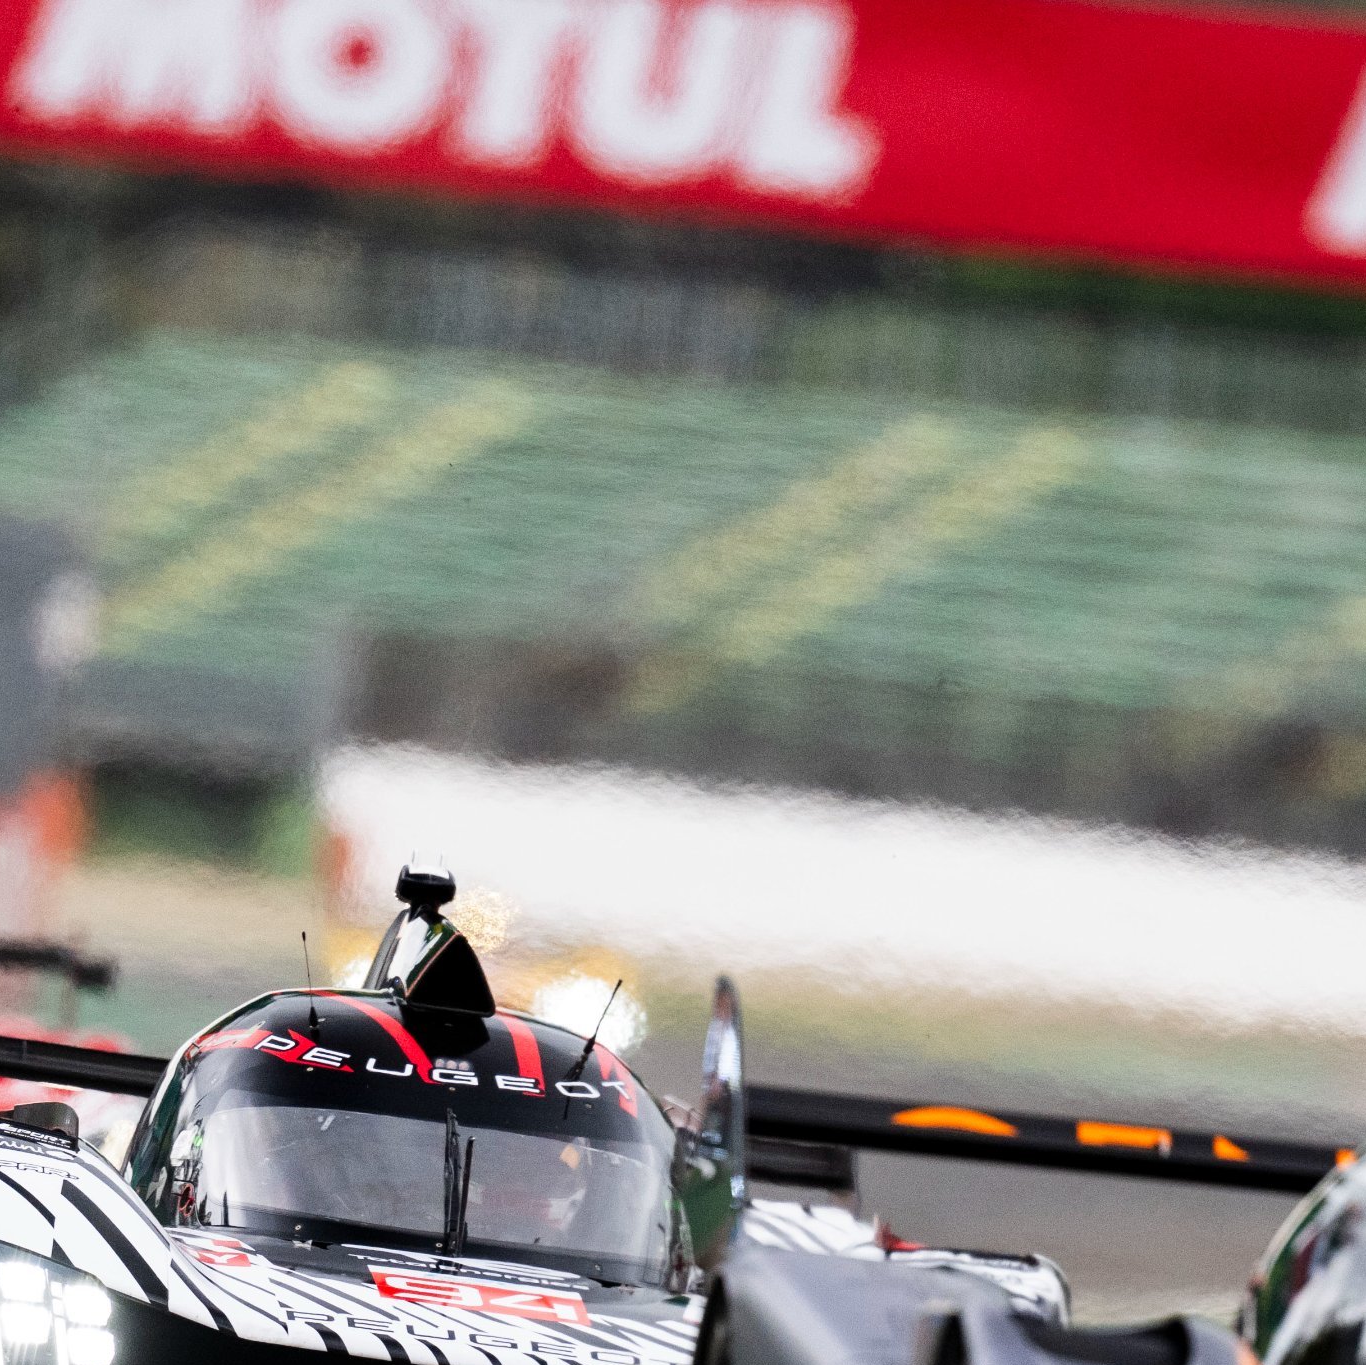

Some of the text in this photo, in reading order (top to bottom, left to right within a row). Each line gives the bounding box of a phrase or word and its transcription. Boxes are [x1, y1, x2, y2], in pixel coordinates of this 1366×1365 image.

[9, 0, 880, 202] MOTUL
[253, 1033, 633, 1100] PEUGEOT
[385, 1274, 578, 1323] 94
